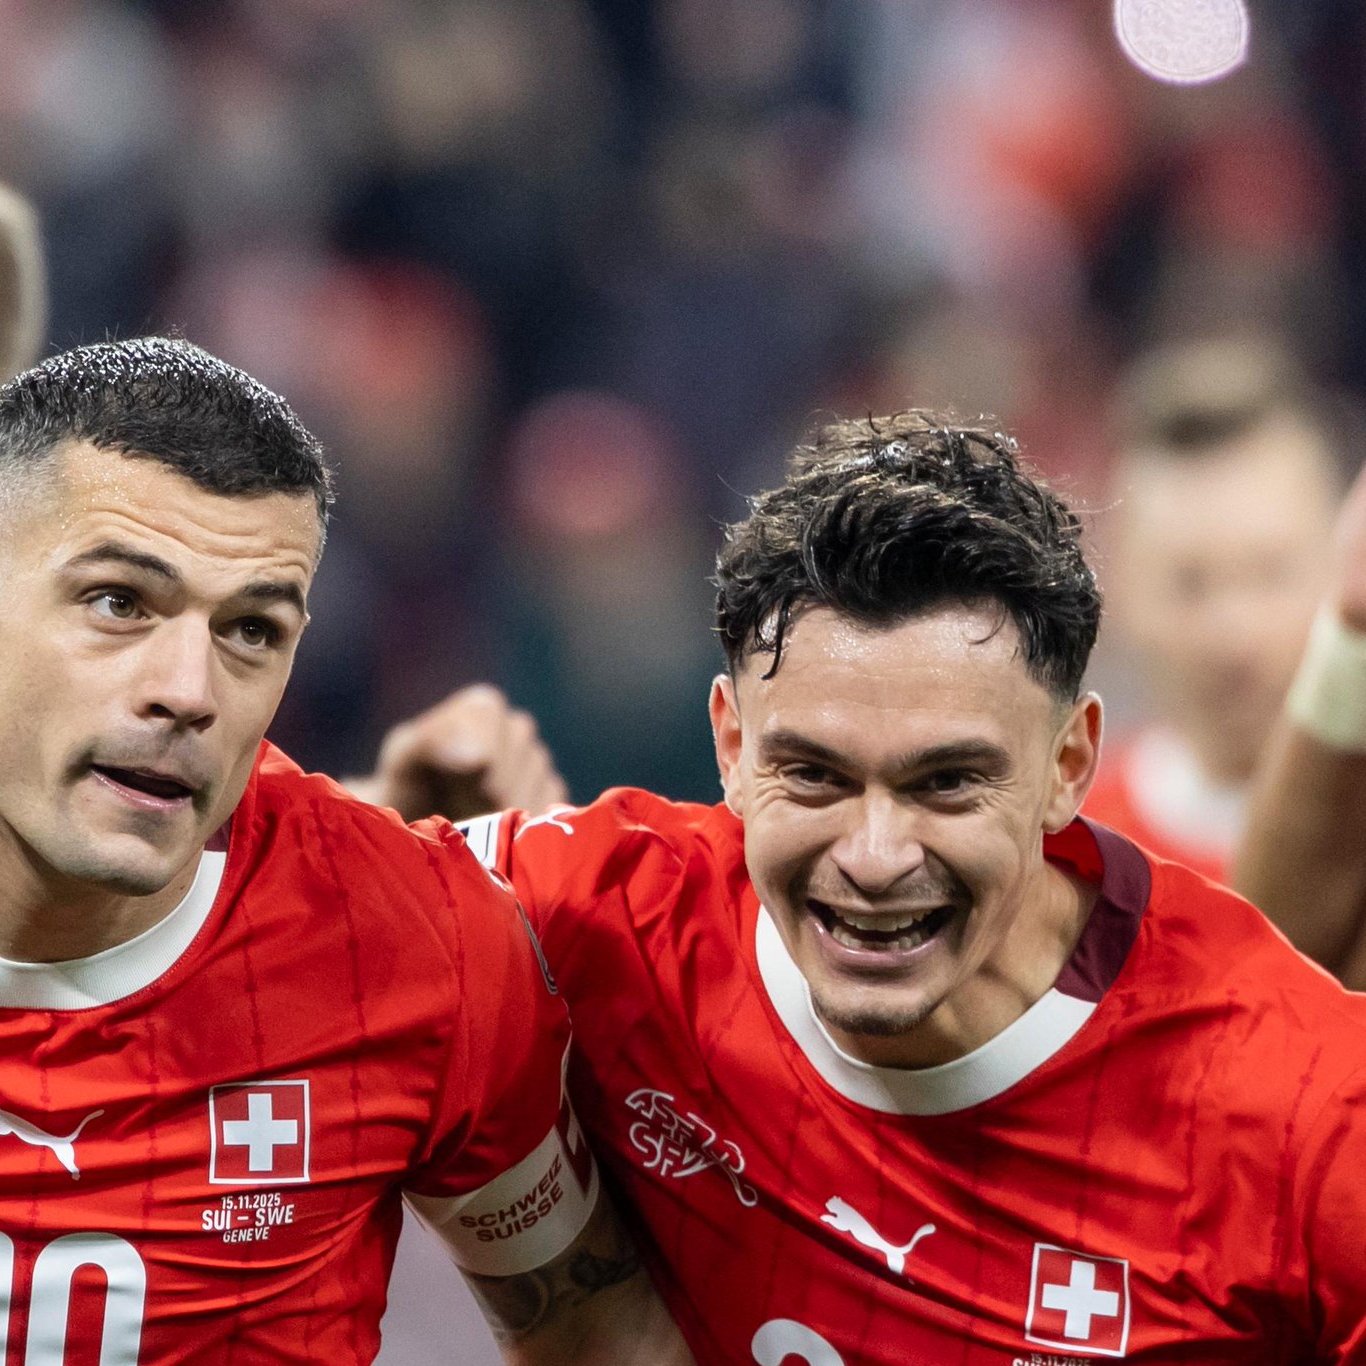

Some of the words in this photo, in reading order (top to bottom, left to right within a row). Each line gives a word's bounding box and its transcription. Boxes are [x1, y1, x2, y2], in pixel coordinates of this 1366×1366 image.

[221, 1192, 281, 1210] 15.11.2025
[459, 1153, 562, 1229] SCHWEIZ
[201, 1209, 232, 1231] SUI
[255, 1204, 295, 1227] SWE
[476, 1181, 564, 1242] SUISSE
[222, 1226, 270, 1243] GENEVE
